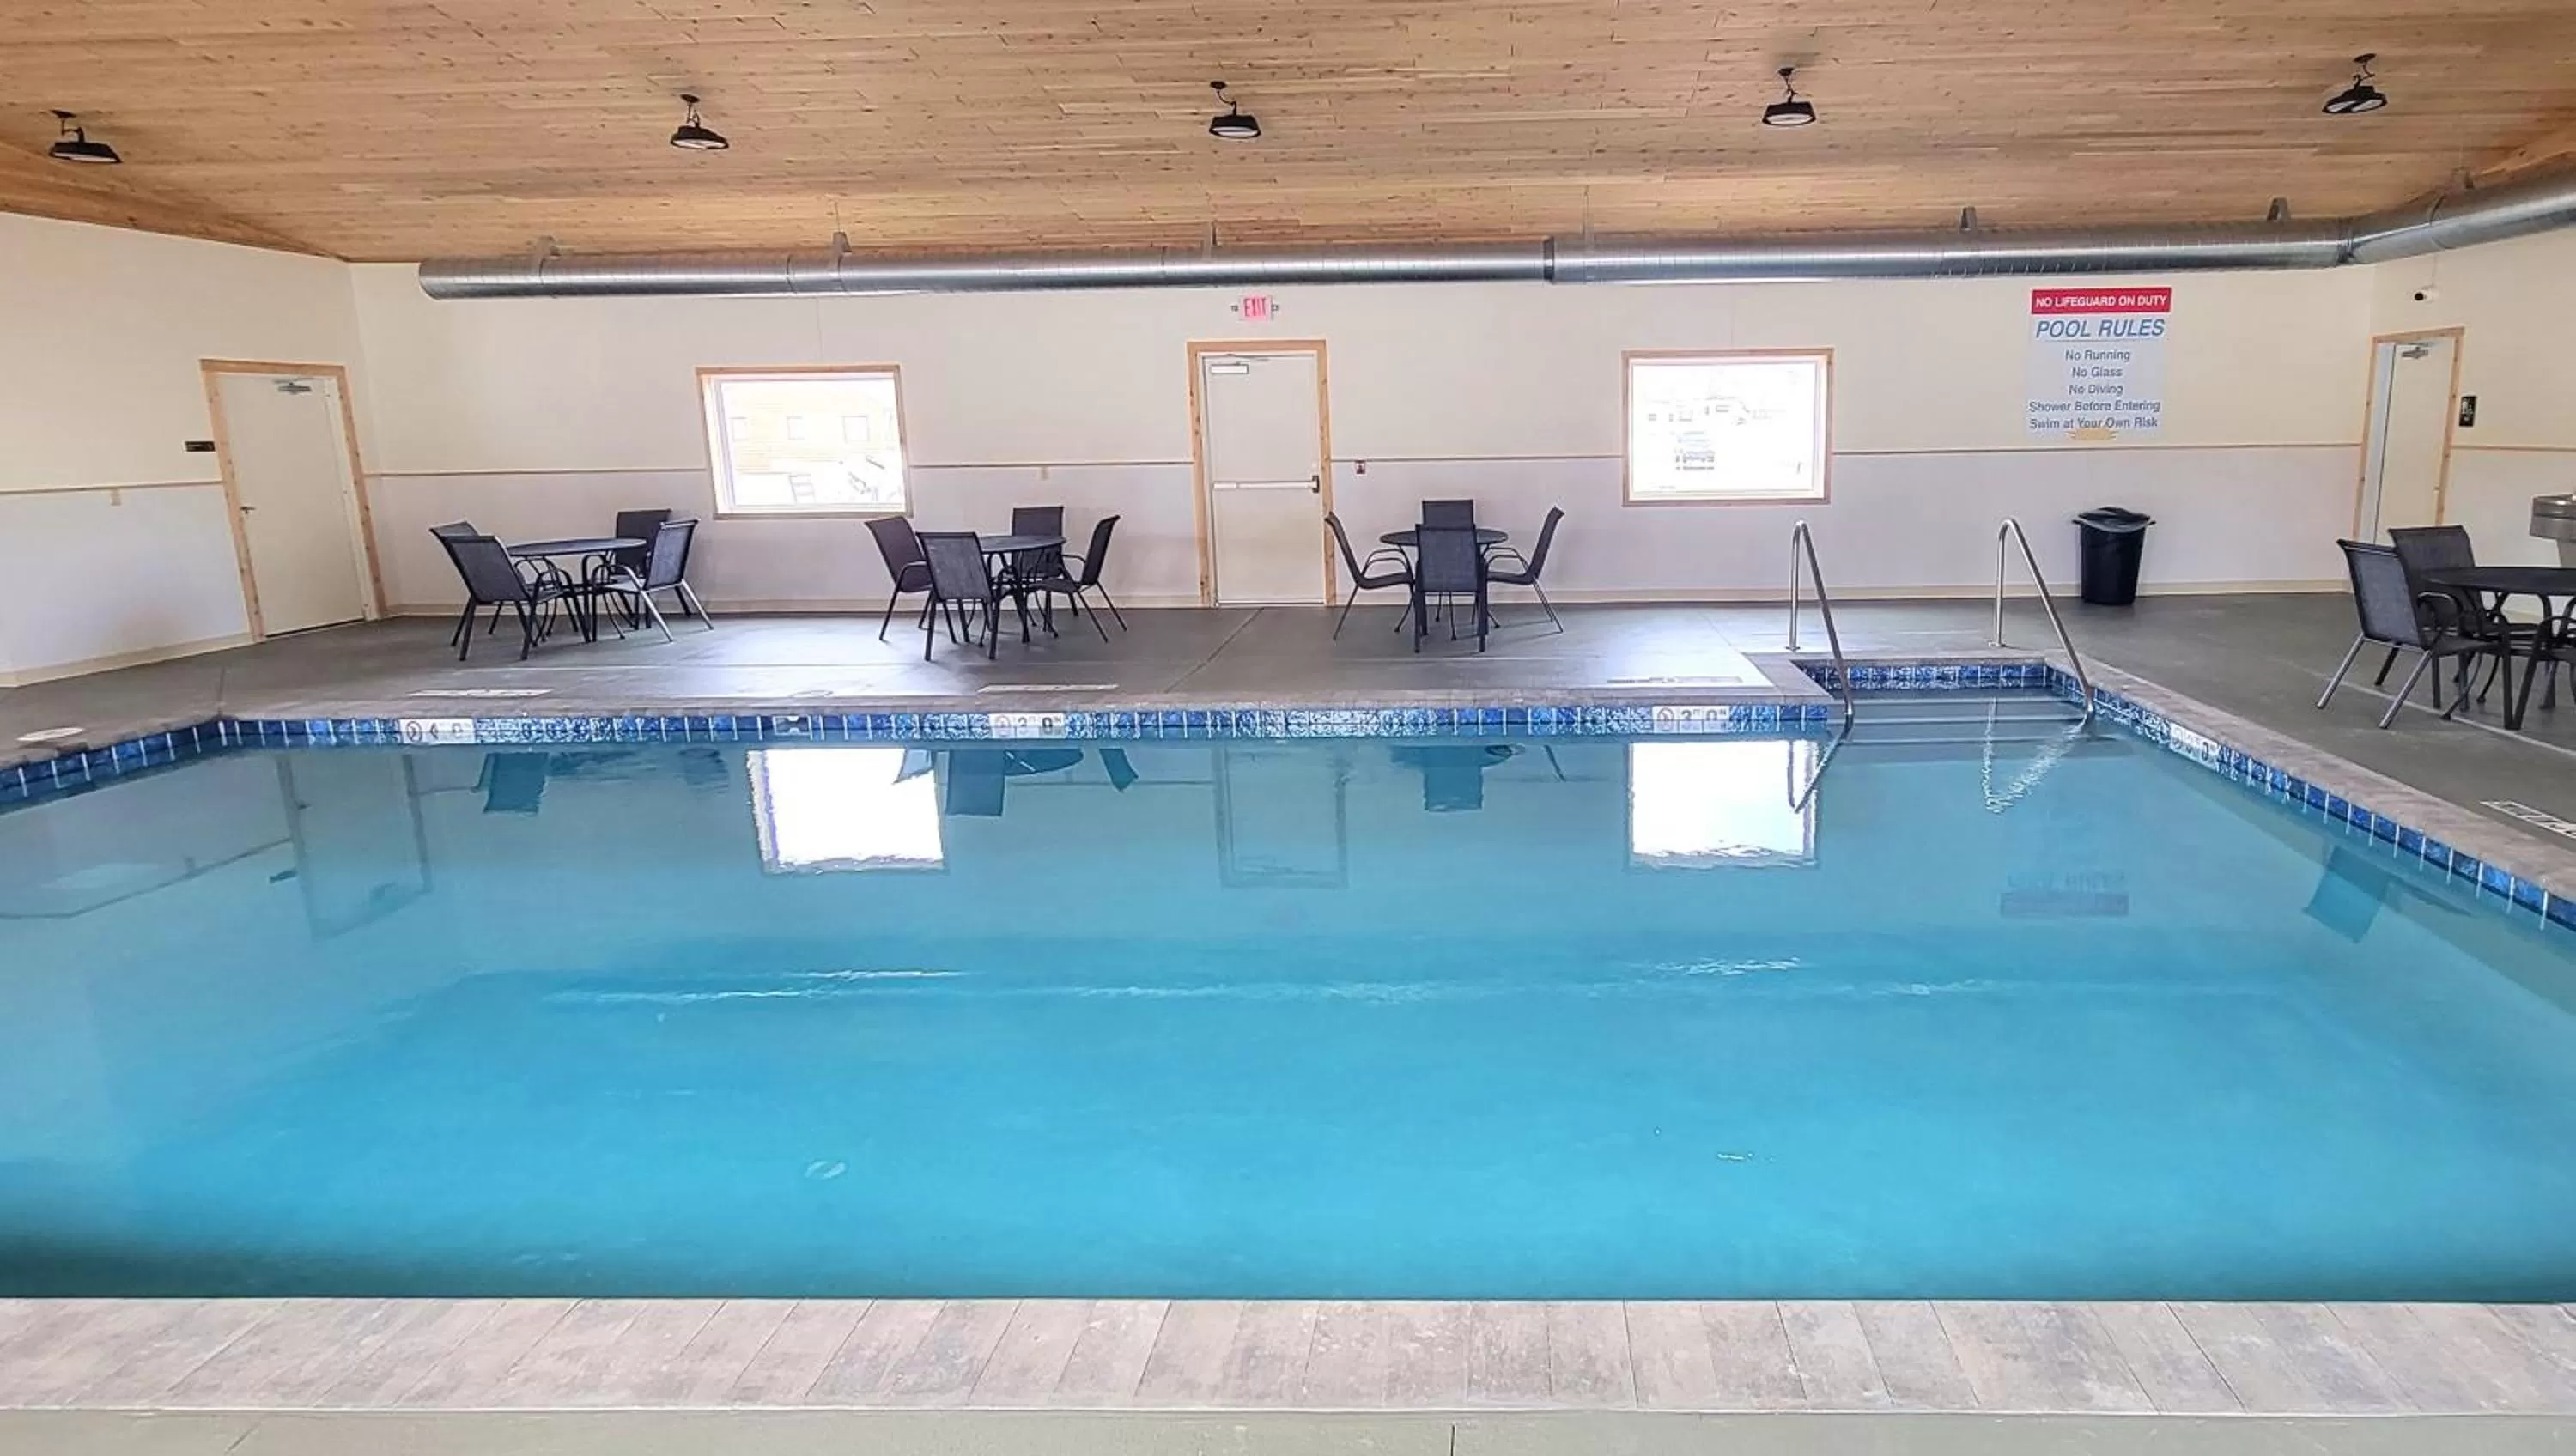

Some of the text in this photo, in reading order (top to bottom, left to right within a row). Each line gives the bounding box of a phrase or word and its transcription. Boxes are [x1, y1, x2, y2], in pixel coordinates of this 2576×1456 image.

[1243, 297, 1267, 317] EXIT
[2036, 294, 2166, 307] NO LIFEGUARD ON DUTY
[2036, 318, 2165, 337] POOL RULES
[2065, 349, 2130, 362] No Running
[2072, 367, 2123, 378] No Glass
[2069, 384, 2123, 396] No Diving
[2029, 400, 2161, 413] Shower Before Entering
[2029, 416, 2158, 429] Swim at Your Own Risk
